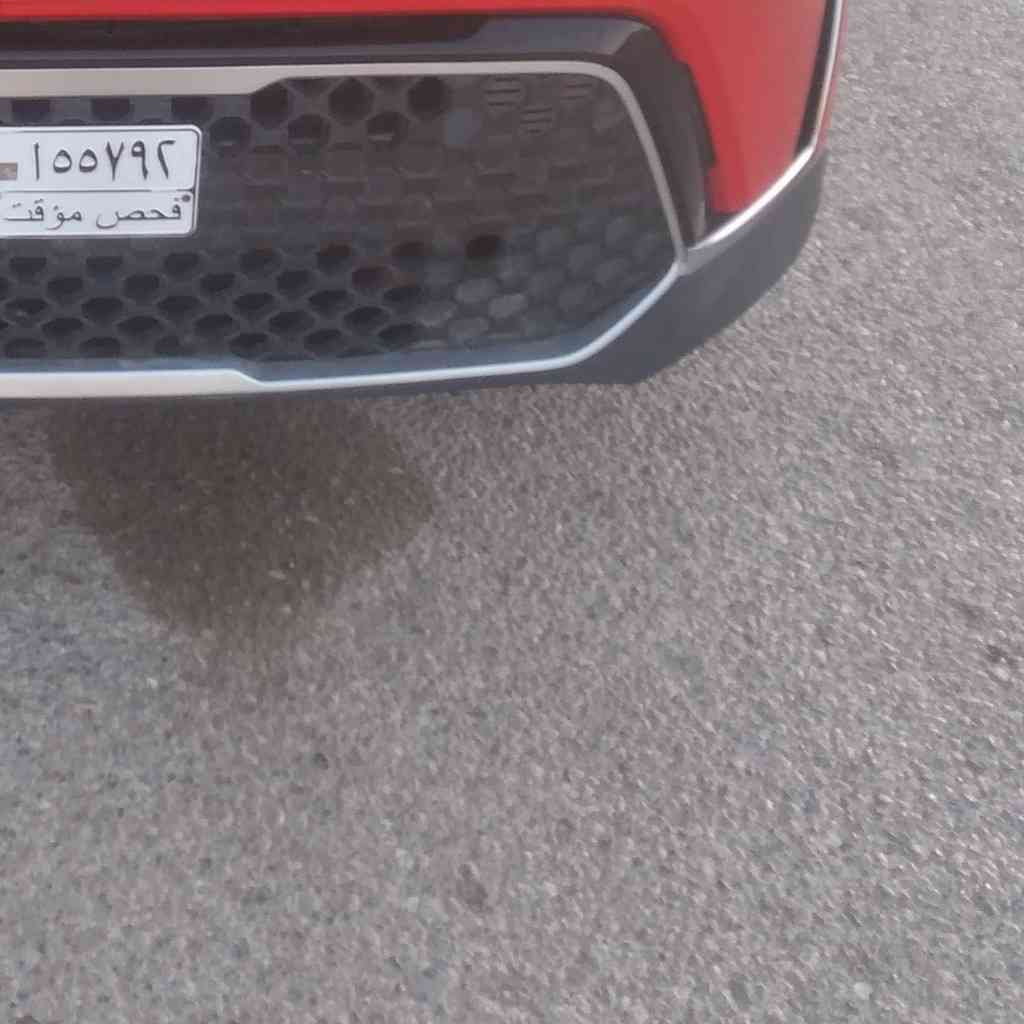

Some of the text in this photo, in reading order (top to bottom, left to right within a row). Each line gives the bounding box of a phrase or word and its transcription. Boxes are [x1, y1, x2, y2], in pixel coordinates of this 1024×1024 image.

[33, 140, 176, 181] ١٥٥٧٩٢
[3, 197, 182, 230] فحص مؤقت
